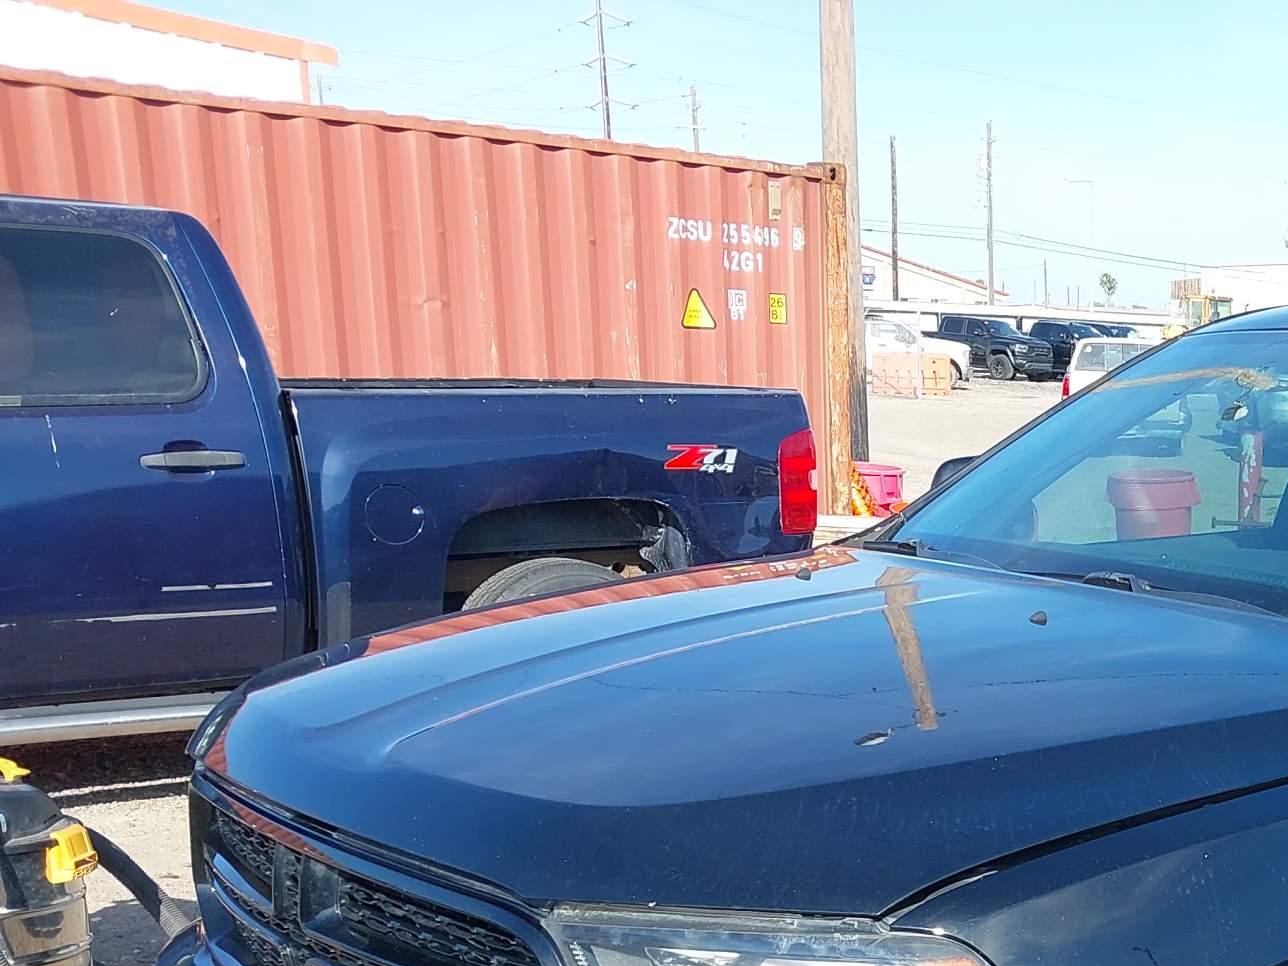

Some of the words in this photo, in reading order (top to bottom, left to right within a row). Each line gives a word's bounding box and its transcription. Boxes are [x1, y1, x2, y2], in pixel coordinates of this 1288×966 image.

[667, 216, 712, 242] ZCSU
[722, 222, 779, 248] 255496
[723, 249, 763, 273] 42G1
[664, 444, 738, 470] Z71
